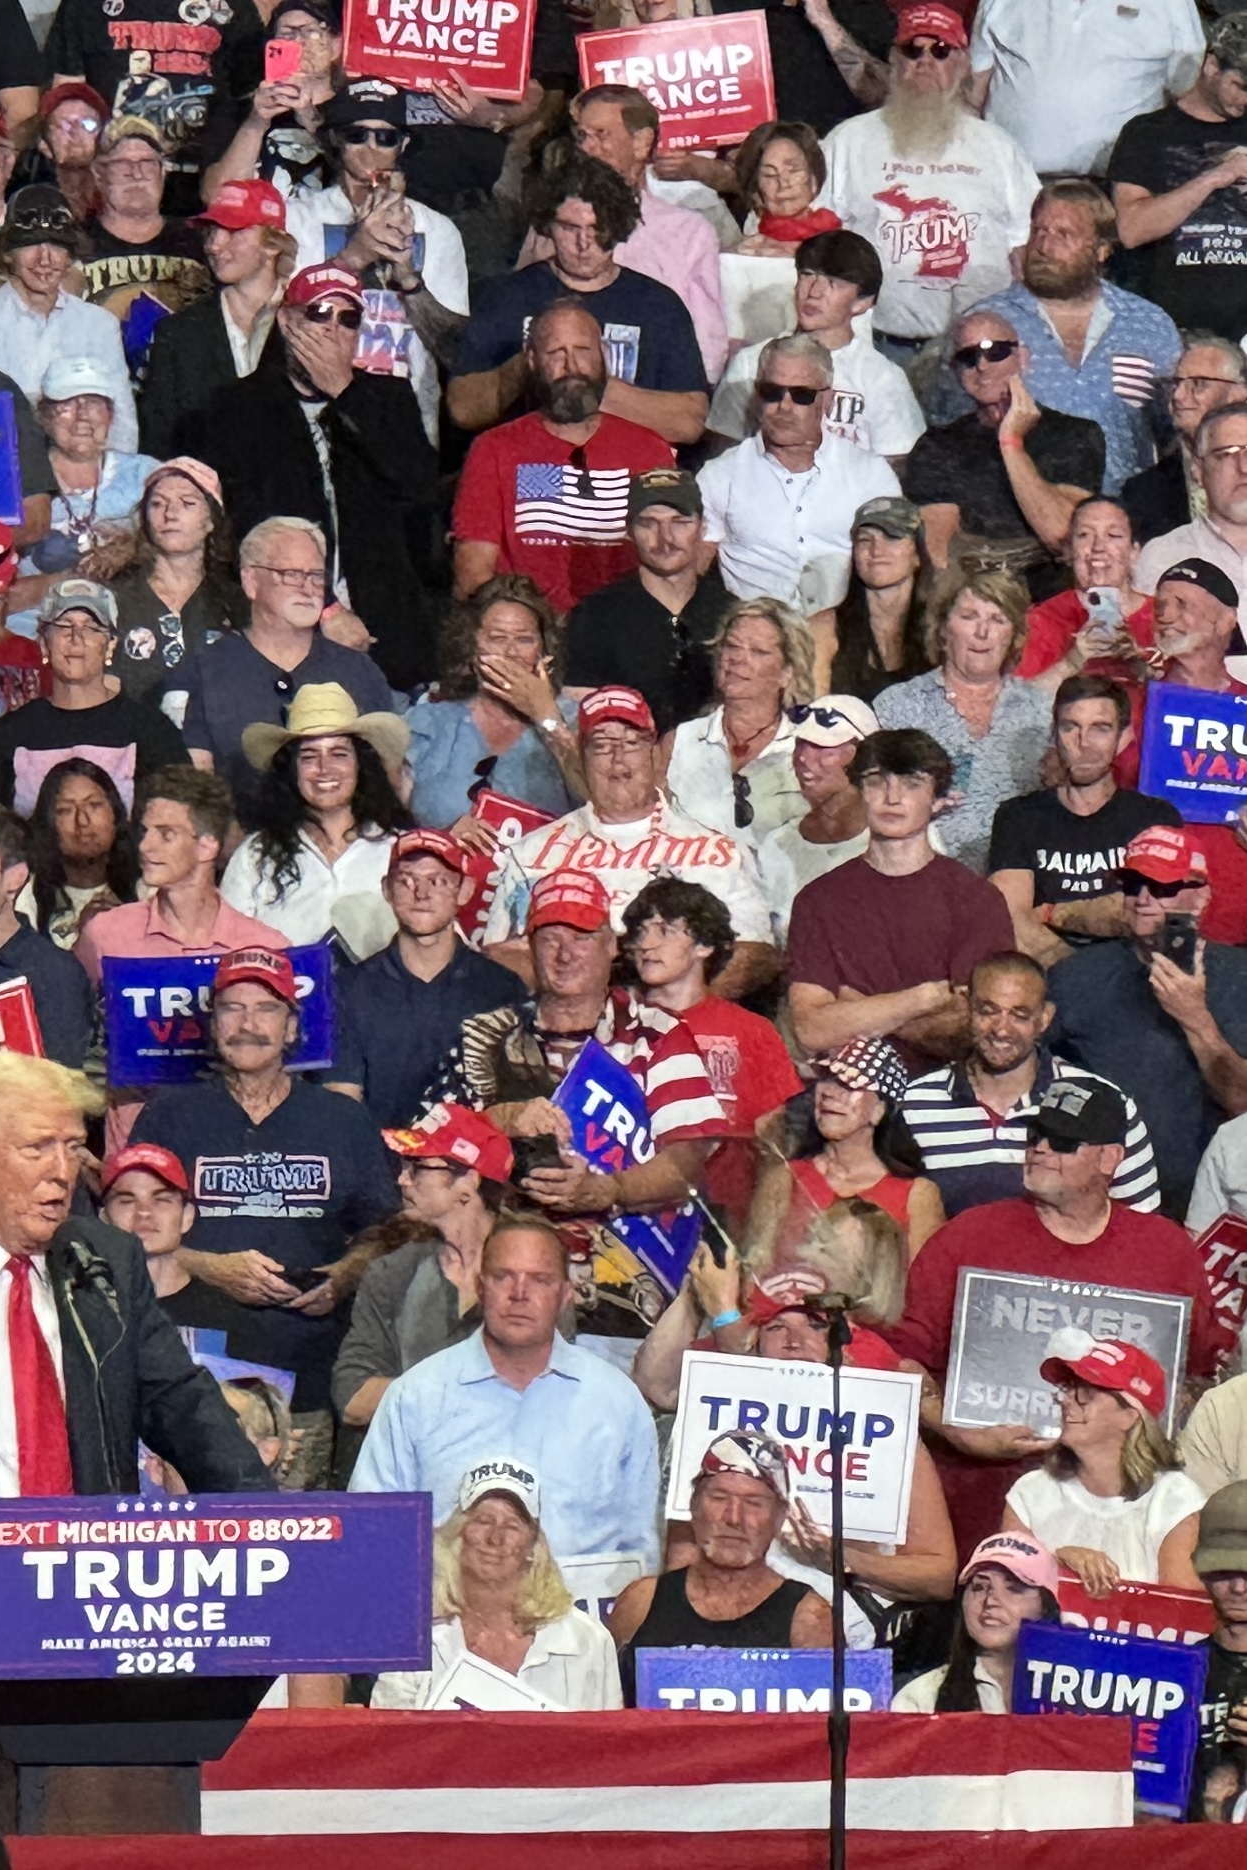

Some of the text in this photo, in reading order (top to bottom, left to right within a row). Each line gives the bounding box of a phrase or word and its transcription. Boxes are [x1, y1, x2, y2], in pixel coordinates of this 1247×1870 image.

[376, 18, 500, 56] VANCE
[594, 43, 754, 87] TRUMP
[646, 77, 742, 110] ANCE
[880, 212, 982, 263] TRUMP
[582, 1078, 656, 1165] TRU
[700, 1394, 895, 1448] TRUMP
[470, 1462, 535, 1485] TRUMP
[783, 1444, 871, 1481] NCE
[57, 1519, 197, 1544] MICHIGAN
[205, 1520, 242, 1542] TO
[247, 1517, 334, 1541] 88022
[22, 1547, 290, 1599] TRUMP
[84, 1602, 227, 1633] VANCE
[116, 1652, 196, 1675] 2024
[1026, 1658, 1185, 1719] TRUMP
